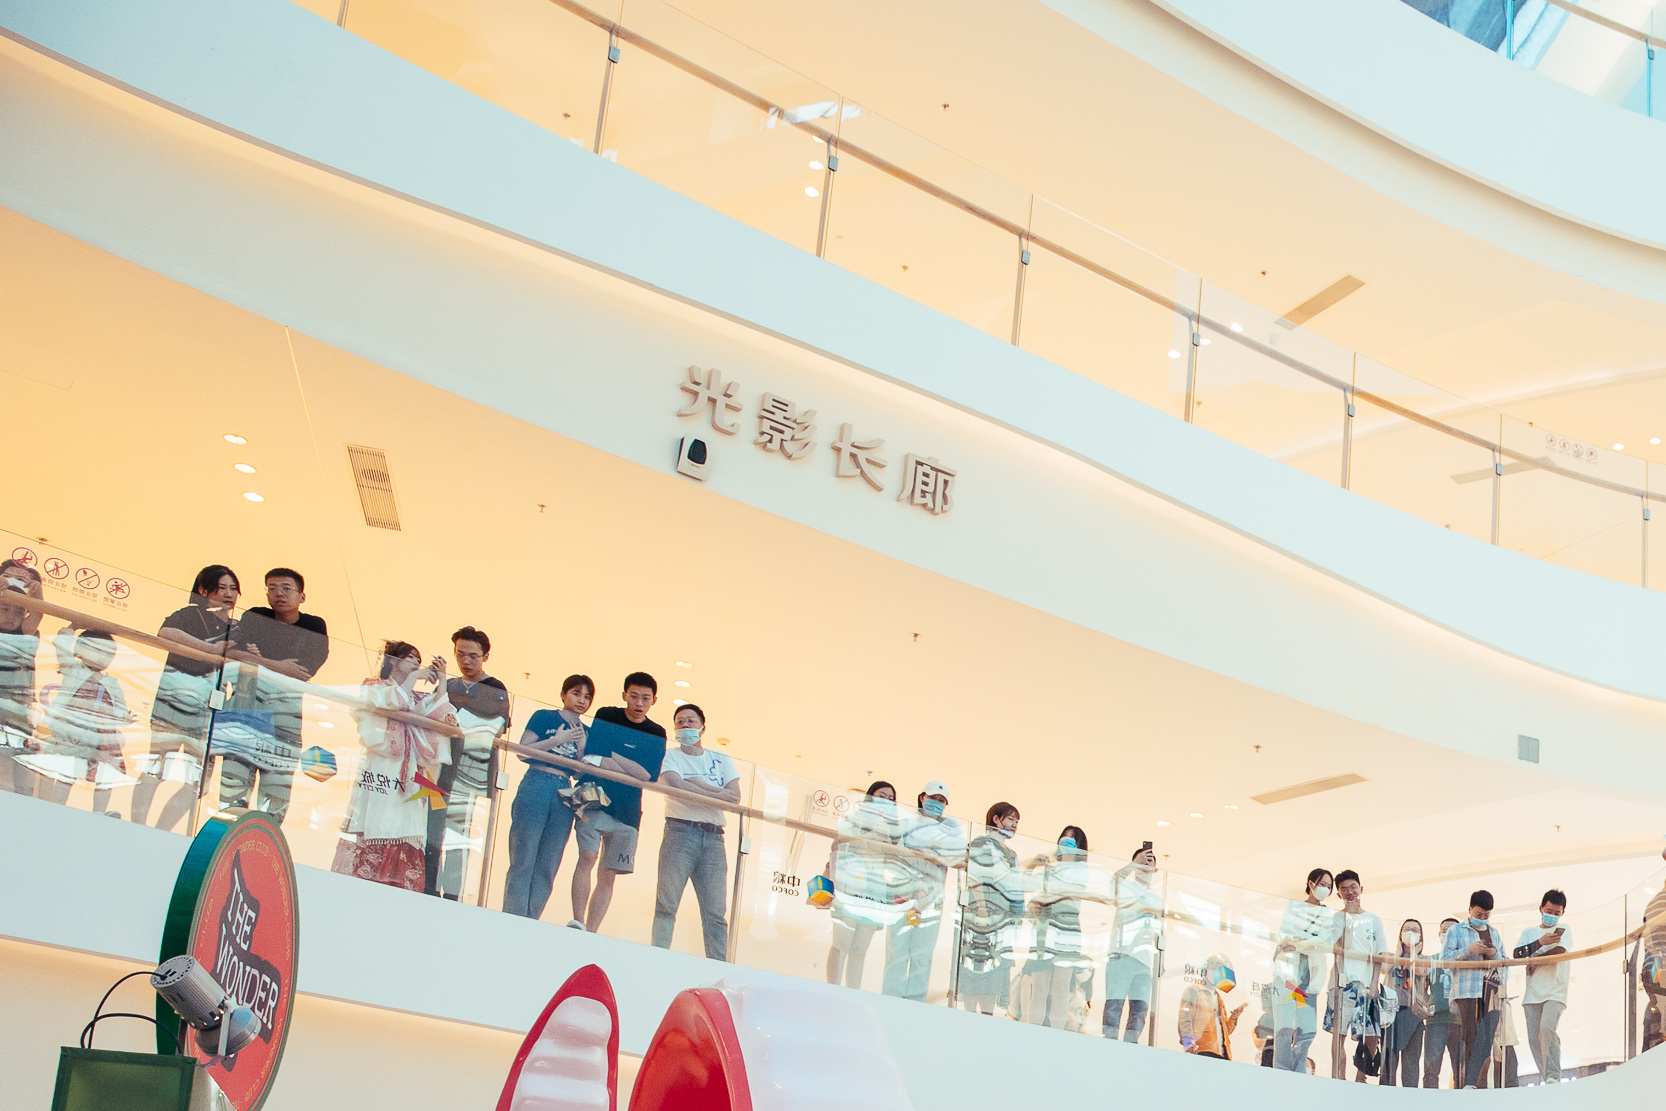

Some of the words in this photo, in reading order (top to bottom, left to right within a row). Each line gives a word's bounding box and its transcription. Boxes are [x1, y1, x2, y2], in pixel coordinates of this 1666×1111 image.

[676, 364, 957, 516] 光影长廊
[227, 867, 257, 951] THE
[216, 922, 279, 1030] WONDER
